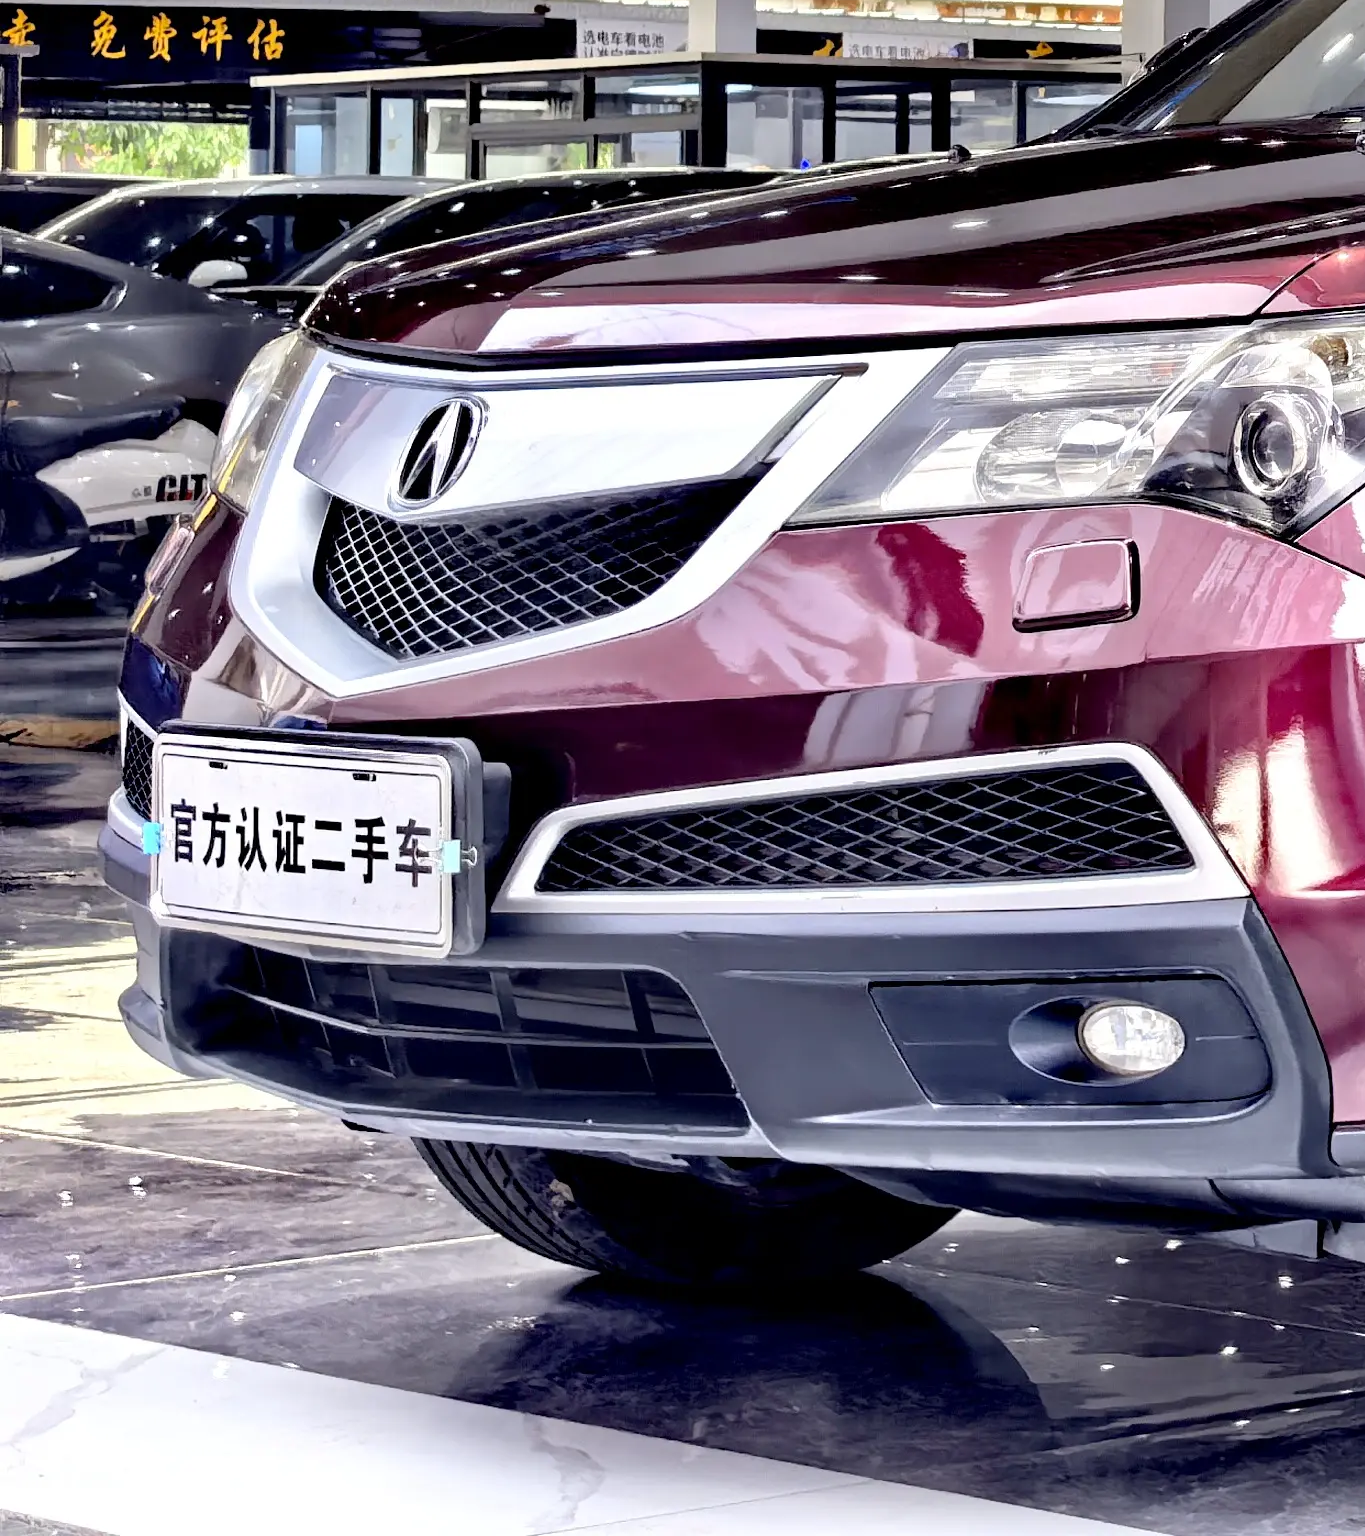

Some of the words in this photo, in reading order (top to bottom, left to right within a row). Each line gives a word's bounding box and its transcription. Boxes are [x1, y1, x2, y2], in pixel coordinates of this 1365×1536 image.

[91, 9, 286, 63] 免费评估
[583, 29, 665, 49] 选电车看电池
[169, 798, 433, 888] 官方认证二手车
